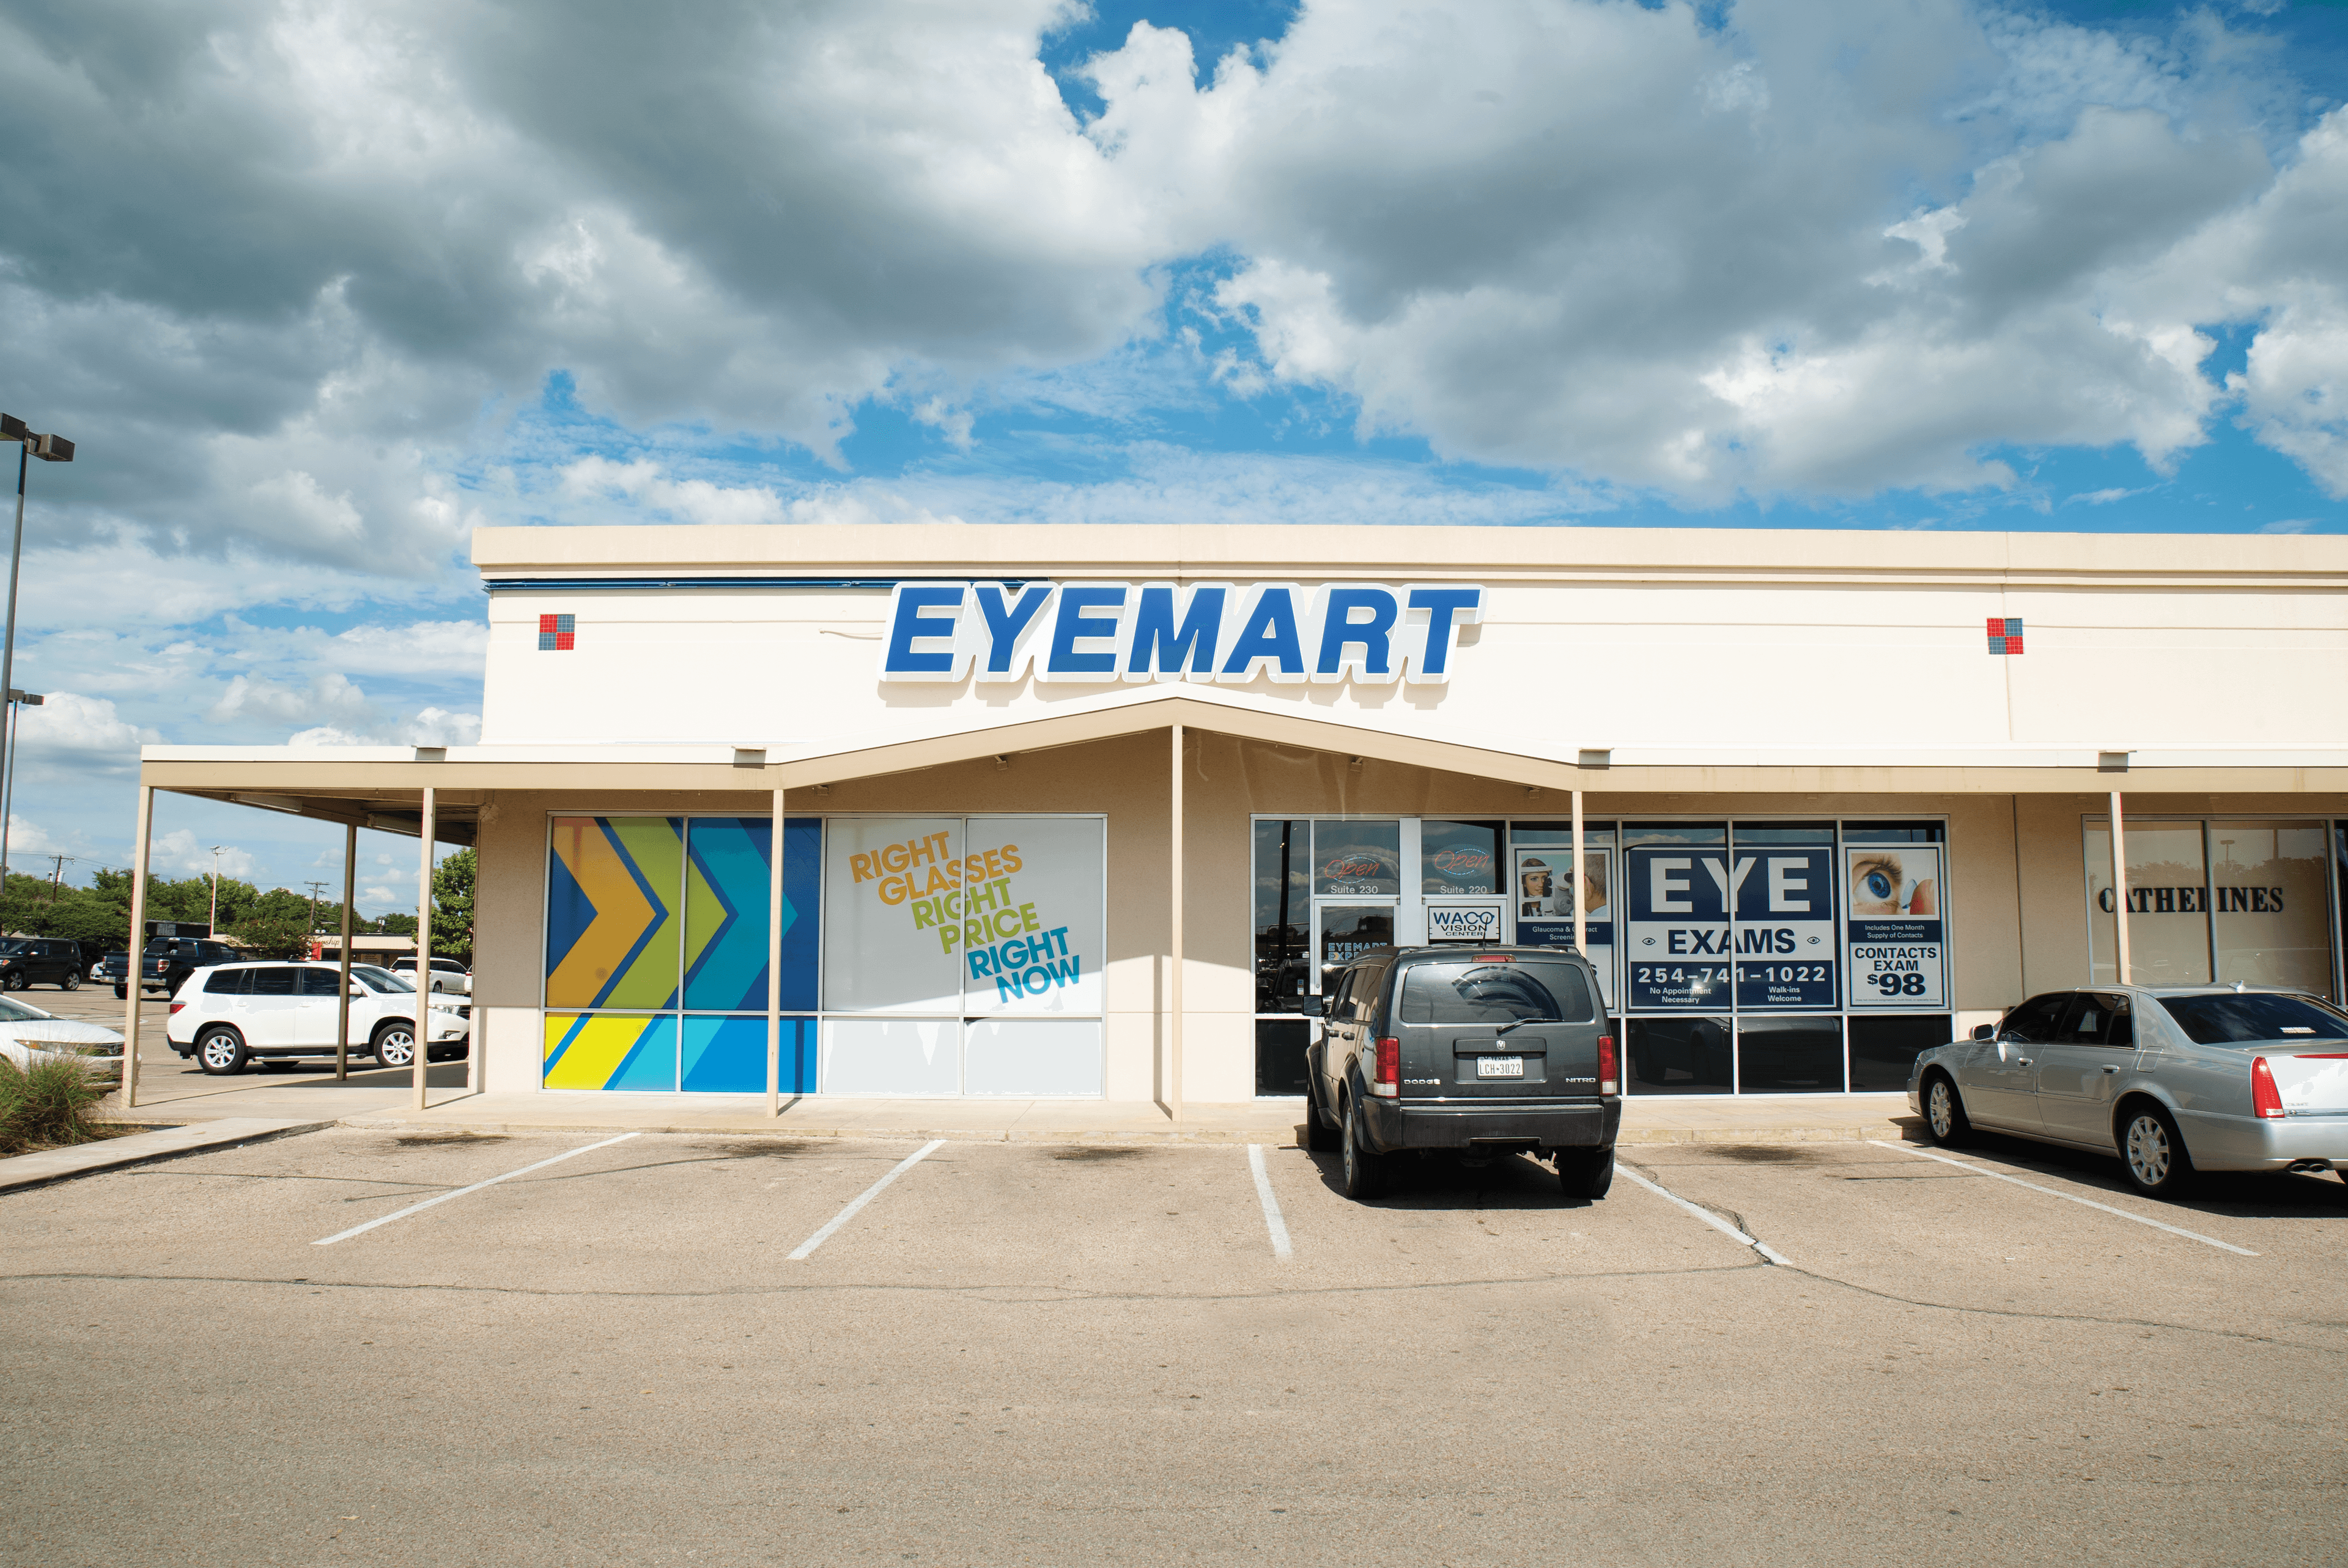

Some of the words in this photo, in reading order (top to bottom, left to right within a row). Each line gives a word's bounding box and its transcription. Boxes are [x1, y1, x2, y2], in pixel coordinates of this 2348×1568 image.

[884, 587, 1482, 675] EYEMART
[849, 830, 950, 883] RIGHT
[1324, 859, 1380, 880] Open
[1434, 850, 1490, 870] Open
[878, 844, 1023, 905] GLASSES
[1650, 856, 1811, 913] EYE
[910, 877, 1011, 930] RIGHT
[938, 902, 1040, 955] PRICE
[1433, 911, 1494, 925] WACO
[967, 926, 1069, 980] RIGHT
[1667, 928, 1796, 955] EXAMS
[1855, 947, 1937, 959] CONTACTS
[995, 954, 1080, 1004] NOW
[1638, 966, 1826, 983] 254-741-1022
[1874, 960, 1919, 971] EXAM
[1662, 987, 1711, 996] Appointment
[1867, 973, 1926, 996] $98
